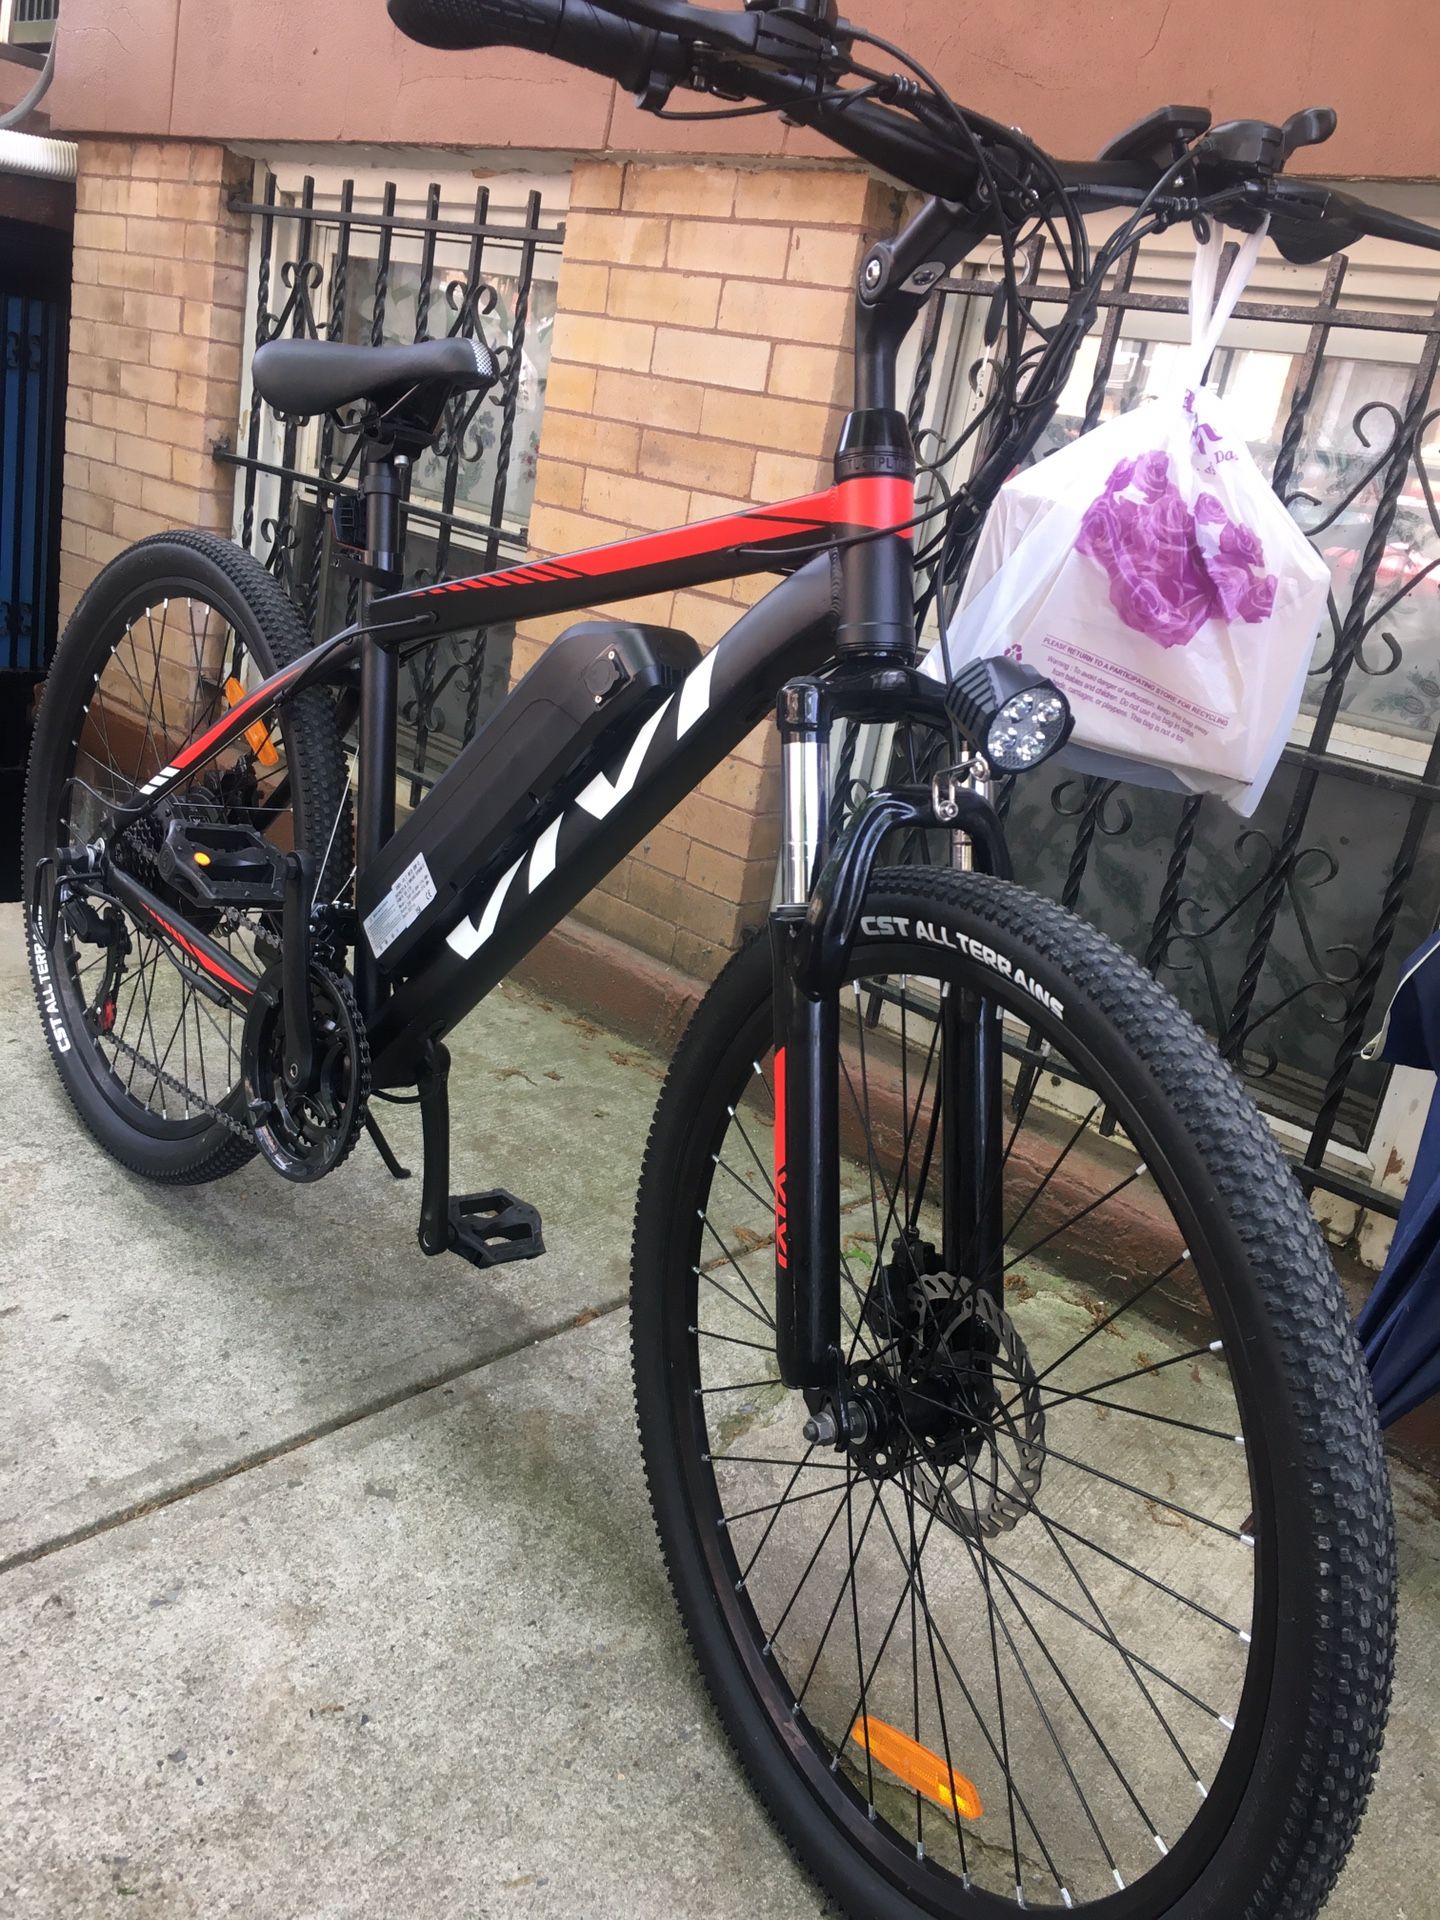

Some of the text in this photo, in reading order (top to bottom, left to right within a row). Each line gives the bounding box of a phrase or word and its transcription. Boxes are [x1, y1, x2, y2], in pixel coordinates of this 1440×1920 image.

[1043, 637, 1067, 650] PLEASE
[1067, 647, 1094, 663] RETURN
[1094, 658, 1103, 667] TO
[1109, 665, 1156, 691] PARTICIPATING
[1155, 688, 1177, 702] STORE
[1177, 699, 1192, 710] FOR
[1191, 706, 1229, 727] RECYCLING
[1051, 668, 1065, 677] from
[1064, 674, 1084, 687] babies
[1084, 682, 1096, 692] and
[1119, 697, 1129, 707] Do
[1129, 703, 1140, 711] not
[1139, 707, 1150, 716] use
[1150, 712, 1162, 721] this
[1161, 716, 1174, 728] bag
[1073, 666, 1081, 674] To
[1081, 671, 1097, 682] avoid
[1097, 678, 1118, 690] danger
[1156, 704, 1171, 716] keep
[1171, 711, 1182, 721] this
[1182, 717, 1194, 728] bag
[1193, 724, 1209, 736] away
[1130, 712, 1142, 724] This
[1142, 719, 1155, 731] bag
[1160, 727, 1171, 737] not
[860, 915, 1065, 1021] CST ALL TERRAINS
[42, 983, 60, 1014] ALL
[49, 1017, 72, 1054] CST
